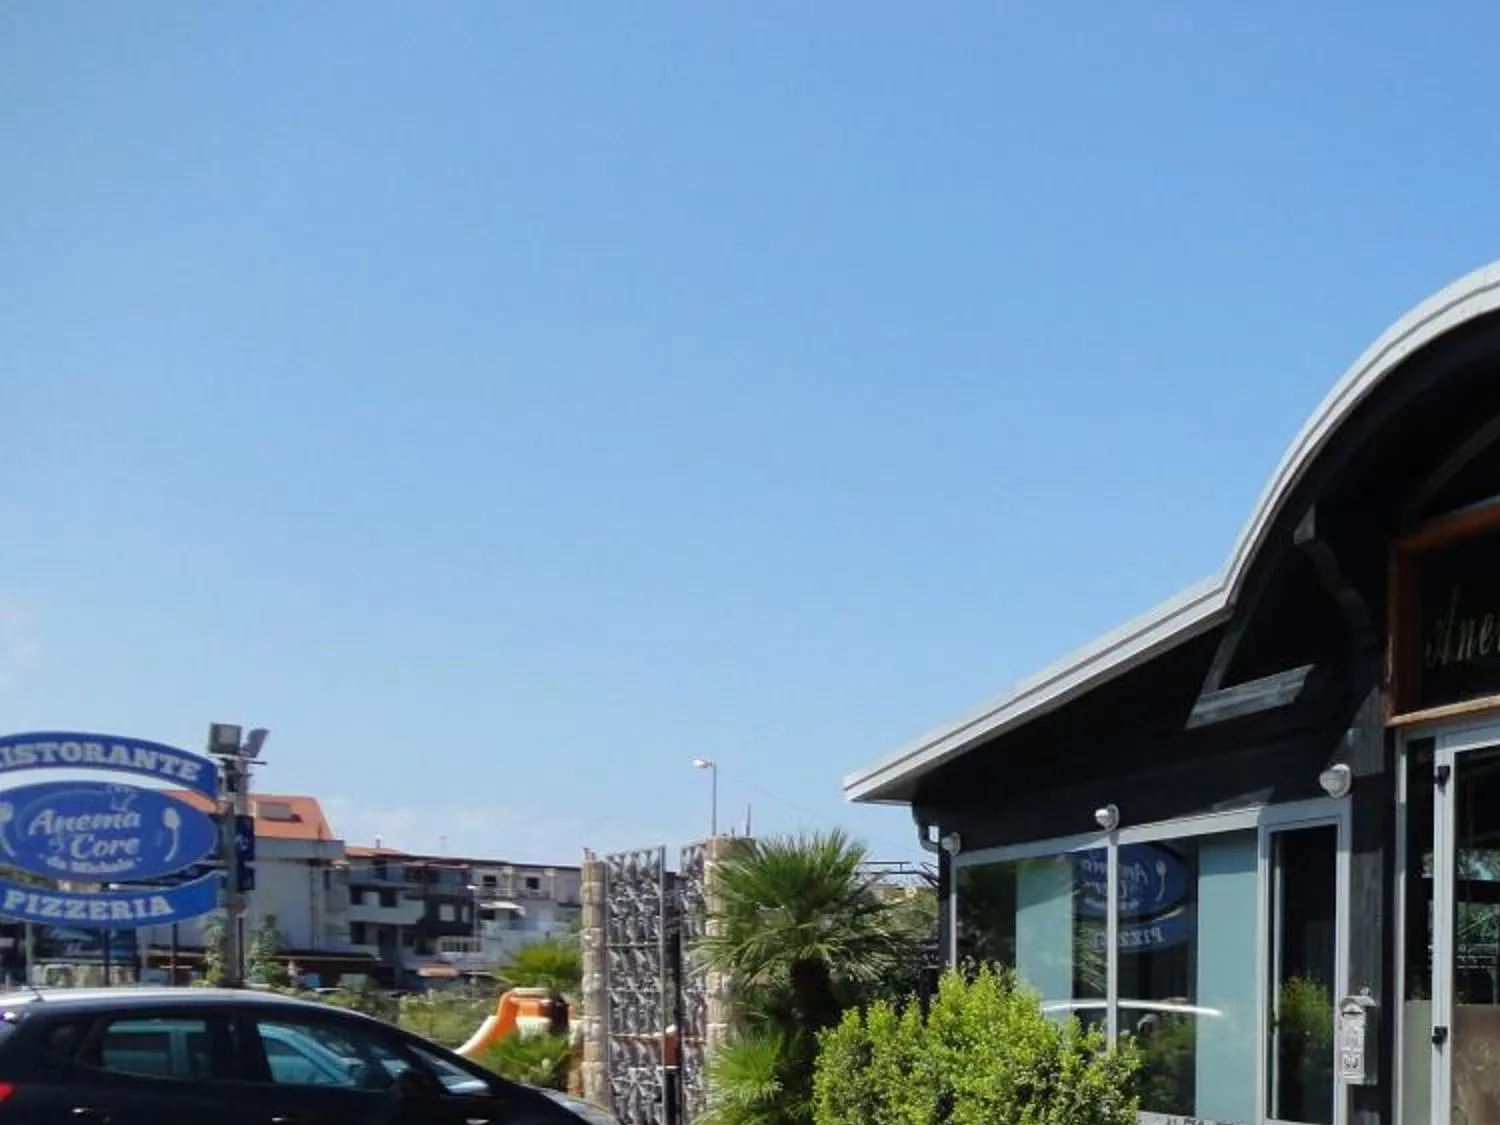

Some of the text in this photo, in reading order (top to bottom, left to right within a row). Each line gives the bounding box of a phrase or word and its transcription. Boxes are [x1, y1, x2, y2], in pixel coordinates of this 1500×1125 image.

[0, 741, 201, 781] ISTORANTE
[28, 808, 142, 836] Anema
[69, 832, 141, 859] Core
[3, 889, 175, 920] PIZZERIA
